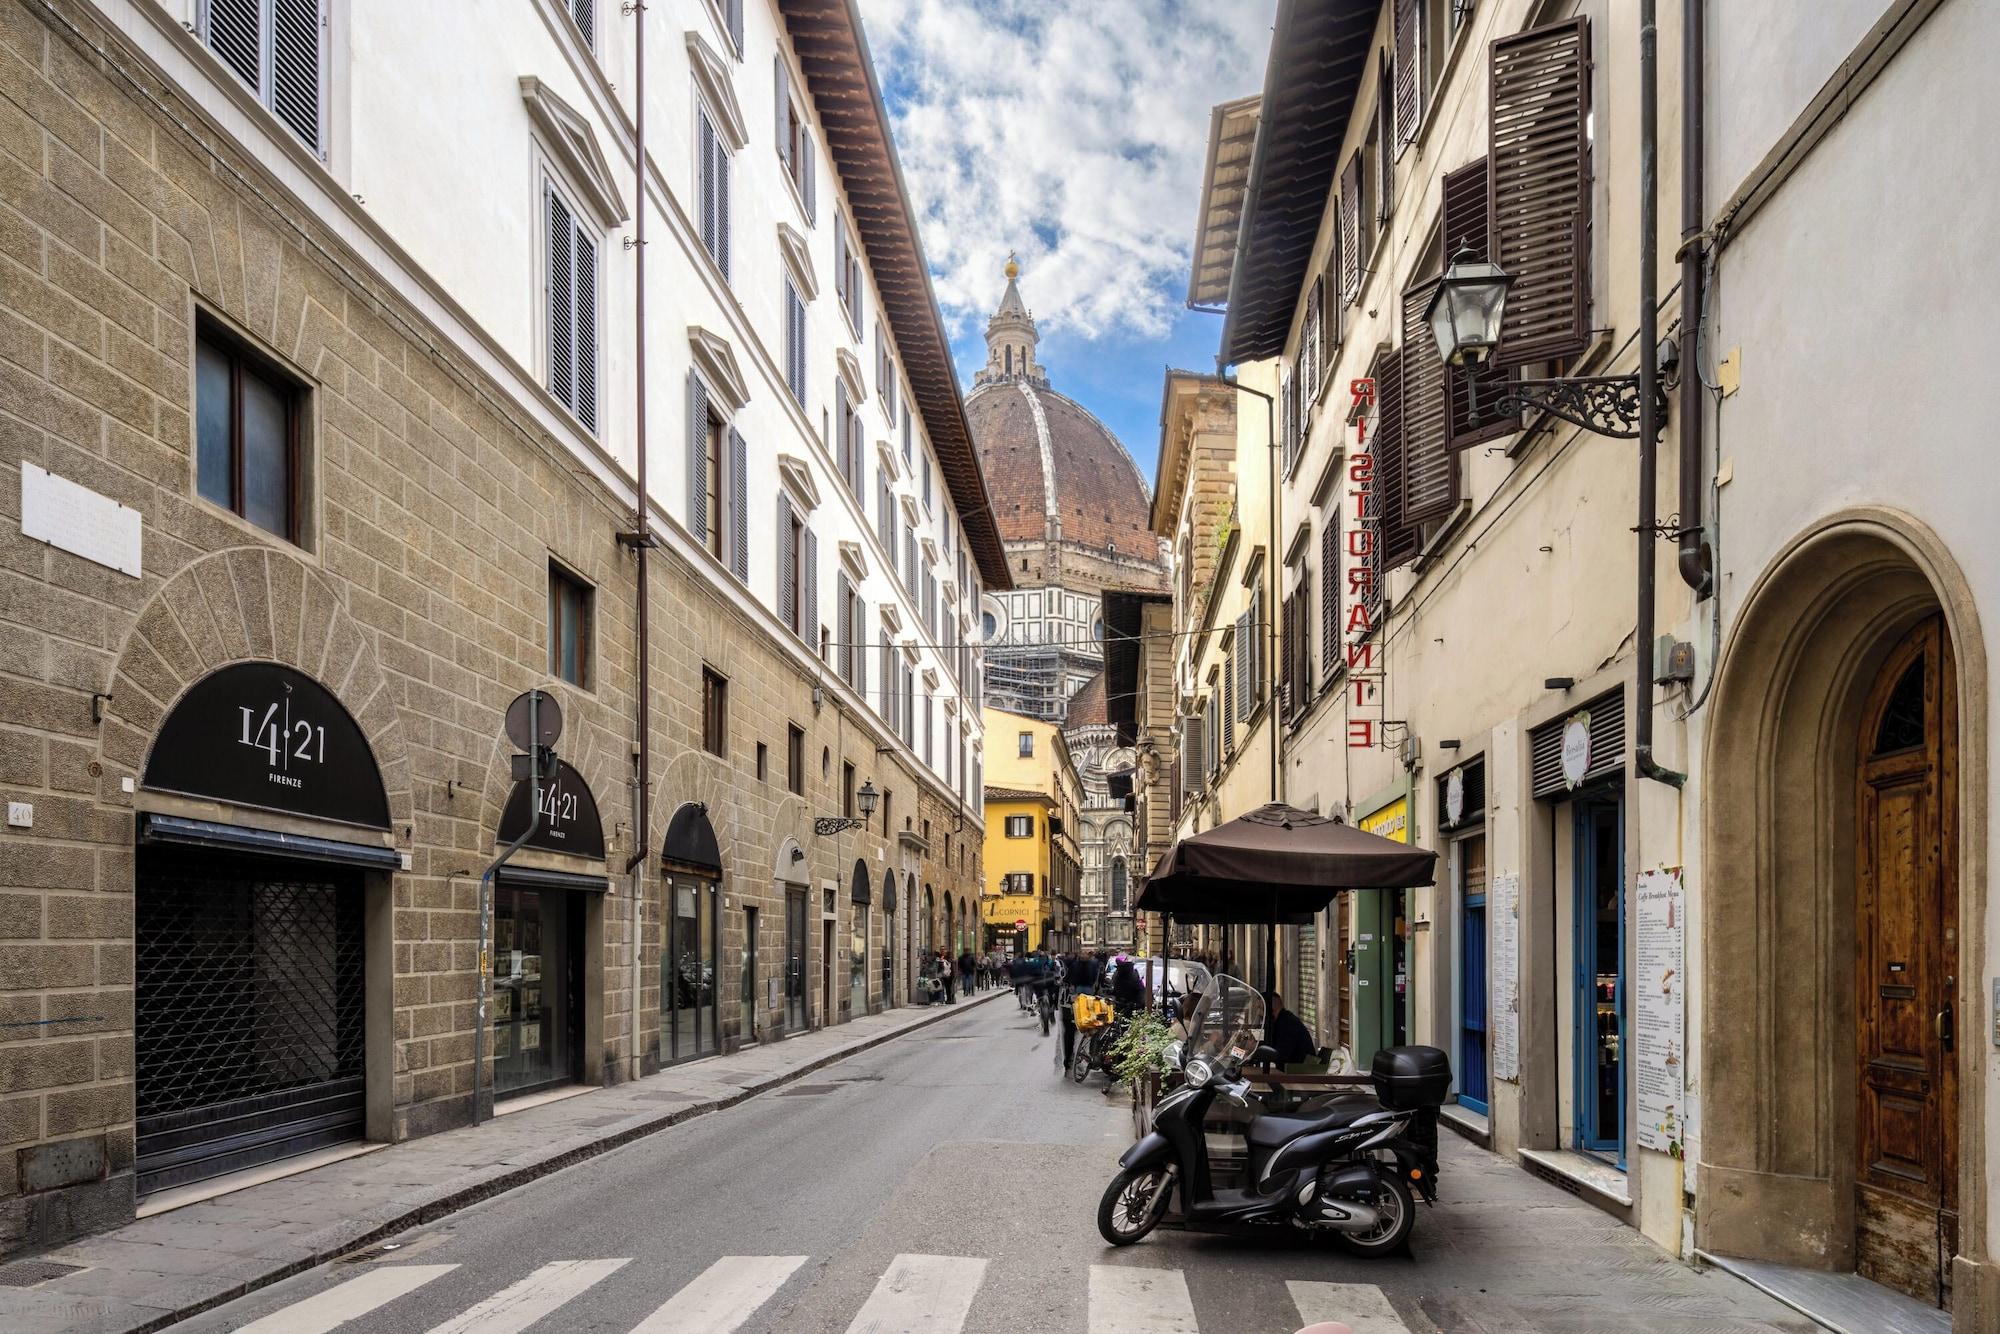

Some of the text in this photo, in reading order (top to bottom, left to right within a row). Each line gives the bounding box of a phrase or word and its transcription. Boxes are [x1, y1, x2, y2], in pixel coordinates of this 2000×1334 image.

[269, 773, 302, 789] FIRENZE
[13, 807, 32, 822] 40
[999, 908, 1030, 917] CORNICI
